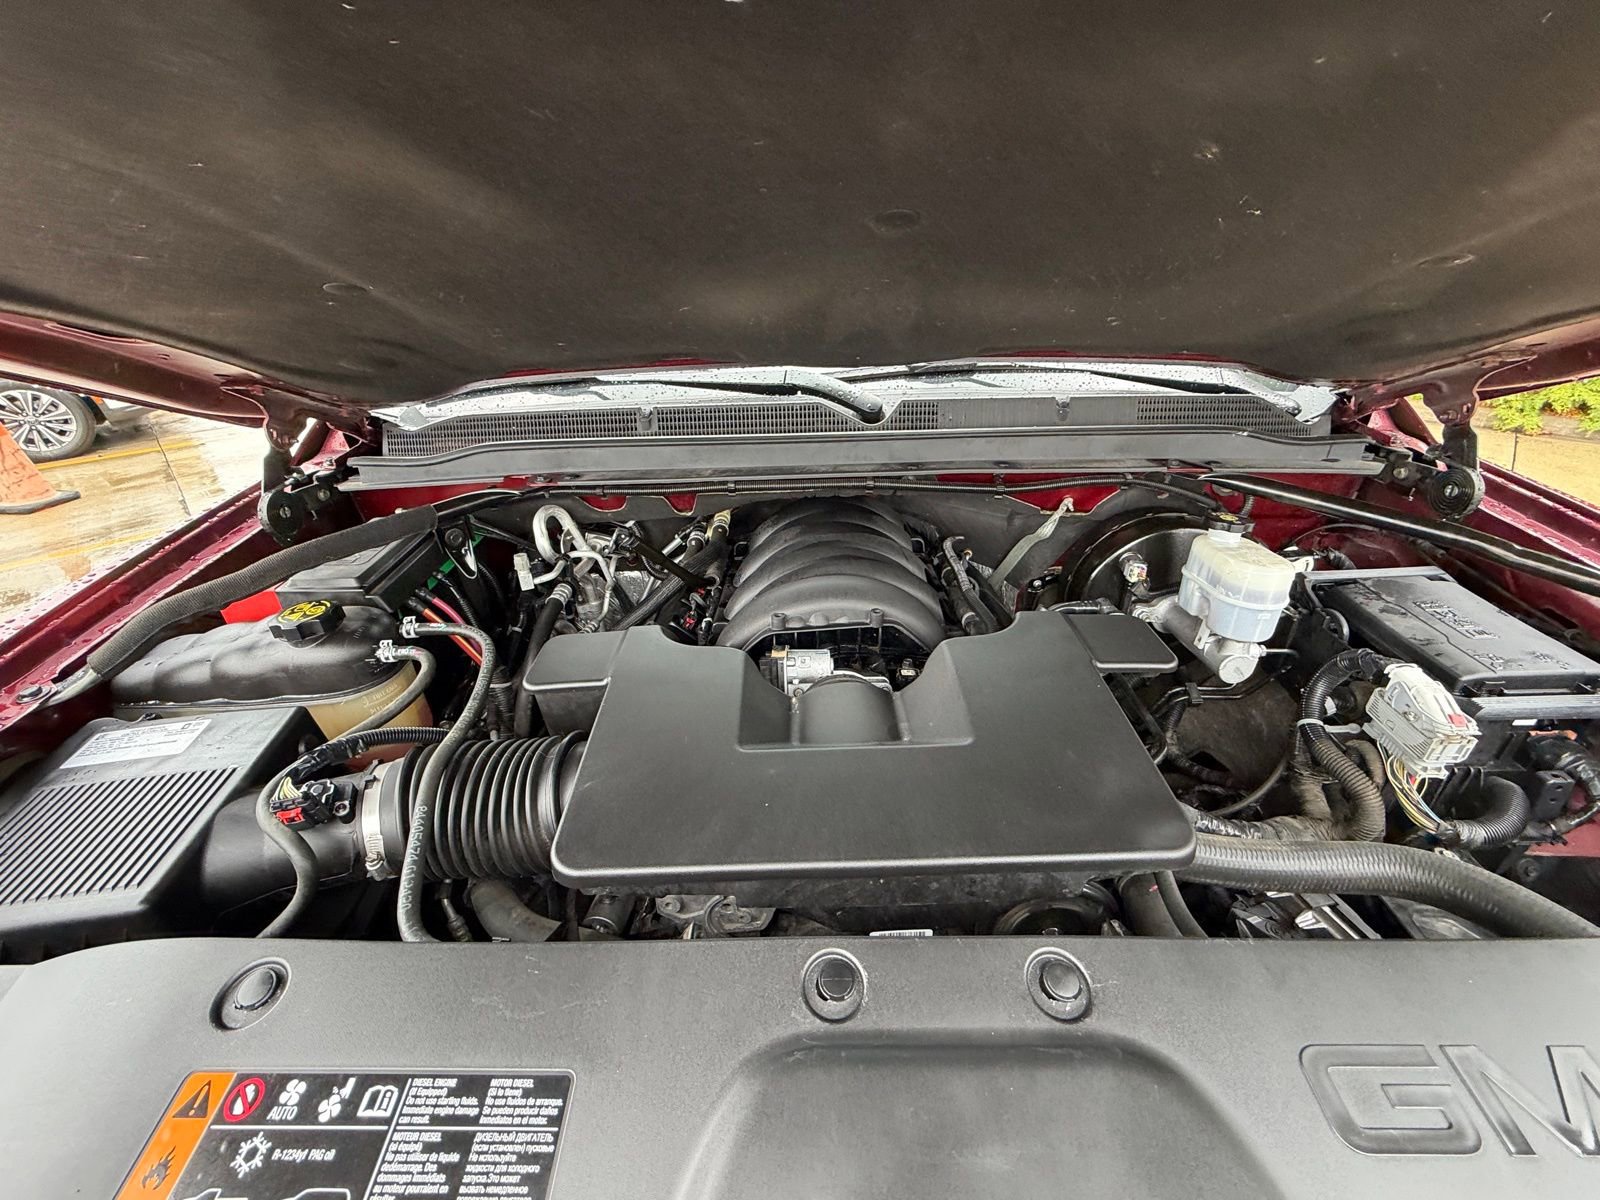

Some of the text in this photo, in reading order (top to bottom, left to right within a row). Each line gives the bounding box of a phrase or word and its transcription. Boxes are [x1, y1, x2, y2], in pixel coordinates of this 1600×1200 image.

[412, 1078, 458, 1087] DIESEL ENGINE
[490, 1079, 534, 1087] MOTOR DIESEL
[417, 1087, 448, 1097] Equipped)
[504, 1088, 522, 1097] tiene)
[406, 1097, 414, 1105] Do
[415, 1097, 426, 1105] not
[437, 1097, 460, 1106] starting
[461, 1097, 478, 1105] fluids.
[485, 1097, 494, 1105] No
[506, 1097, 526, 1105] fluidos
[527, 1097, 535, 1105] de
[535, 1098, 563, 1107] arranque.
[266, 1106, 297, 1120] AUTO
[402, 1106, 479, 1116] Immediate engine damage
[482, 1106, 491, 1114] Se
[490, 1107, 514, 1115] pueden
[513, 1107, 539, 1116] producir
[411, 1115, 429, 1123] result.
[521, 1116, 529, 1124] el
[392, 1132, 441, 1141] MOTEUR DIESEL
[474, 1131, 554, 1143] ДИЗЕЛЬНЫЙ ДВИГАТЕЛЬ
[272, 1149, 336, 1163] R-1234yf PAG oil
[385, 1152, 460, 1163] Ne pas utiliser de liquide
[469, 1153, 478, 1161] Не
[424, 1162, 437, 1172] Des
[494, 1165, 507, 1173] для
[377, 1174, 412, 1184] dommages
[500, 1175, 521, 1183] может
[373, 1184, 449, 1195] au moteur pourraient en
